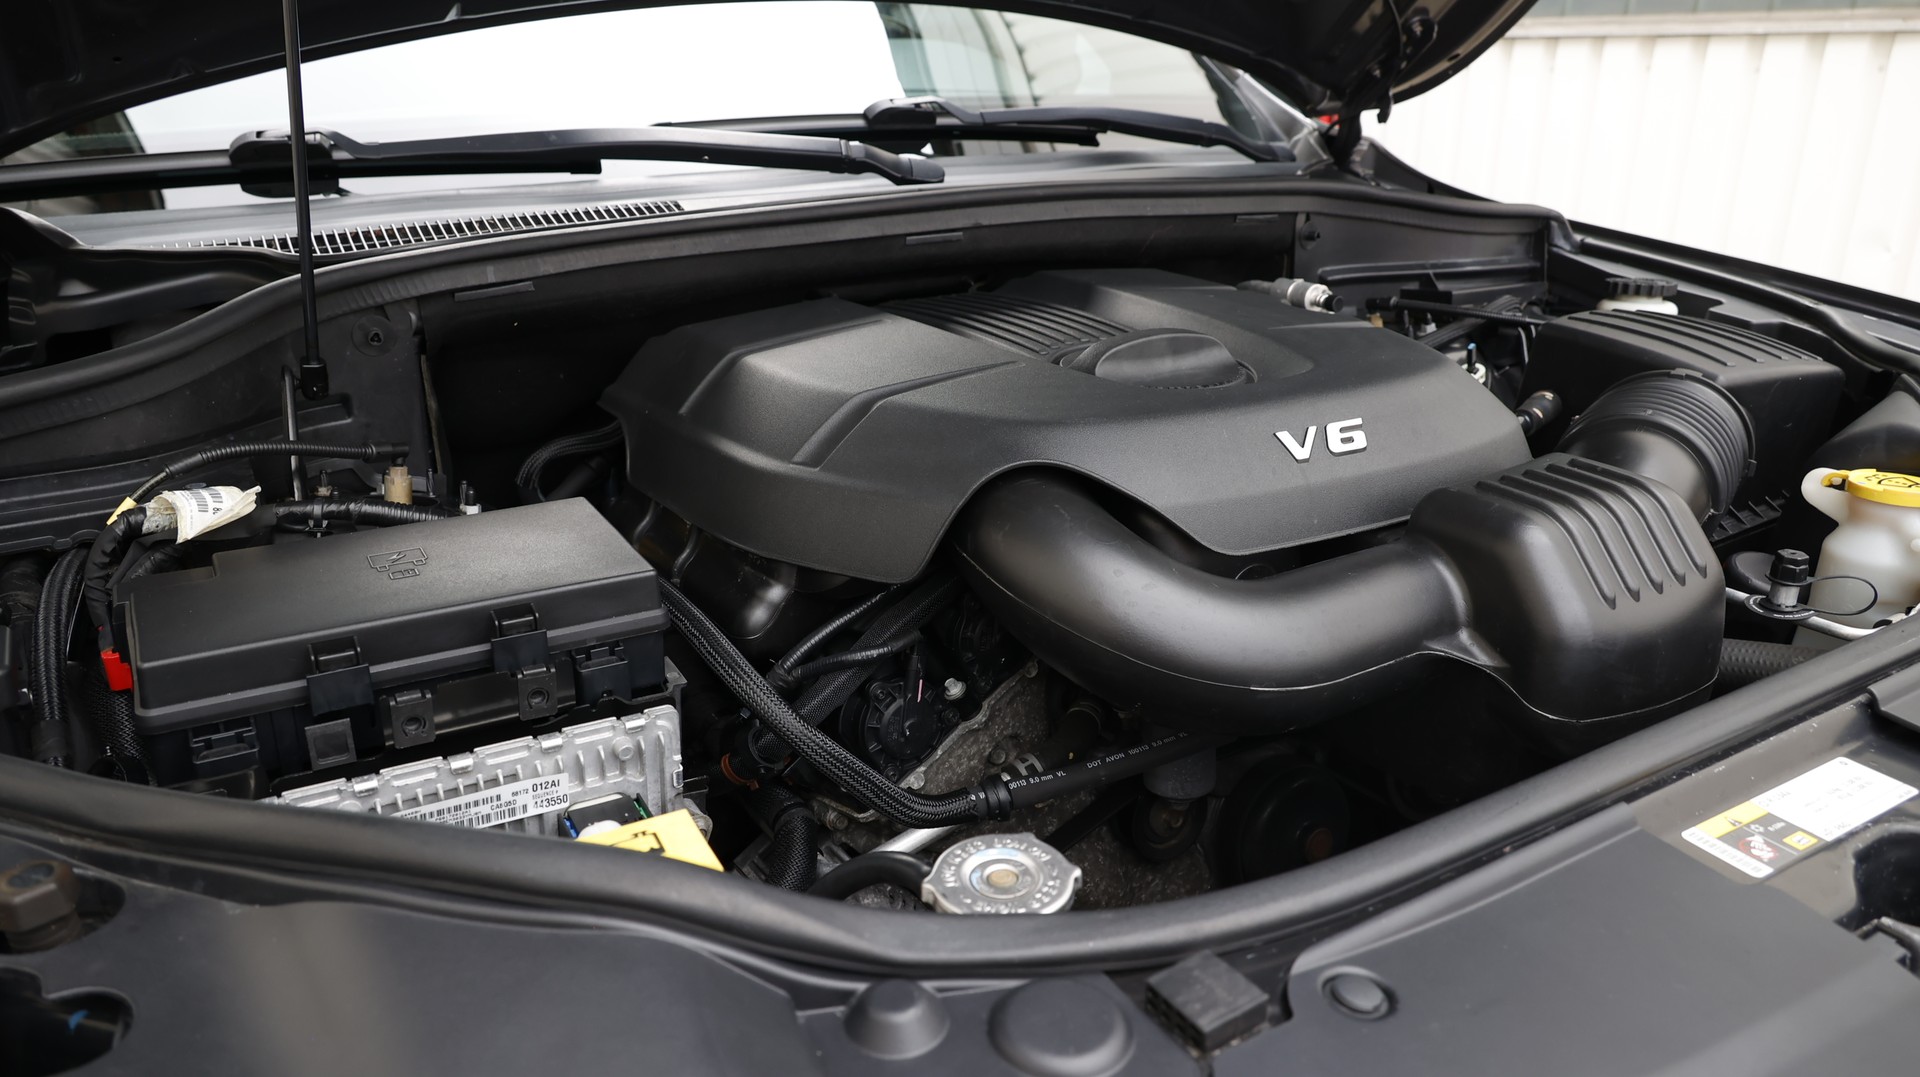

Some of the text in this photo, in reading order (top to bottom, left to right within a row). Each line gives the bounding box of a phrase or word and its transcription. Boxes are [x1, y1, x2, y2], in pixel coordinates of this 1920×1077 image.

[1273, 417, 1368, 464] V6
[1086, 759, 1102, 769] DOT
[1105, 752, 1125, 763] AVON
[1128, 744, 1149, 755] 100113
[1008, 779, 1027, 790] 00113
[1029, 776, 1040, 784] 9.0
[533, 793, 568, 808] 443550
